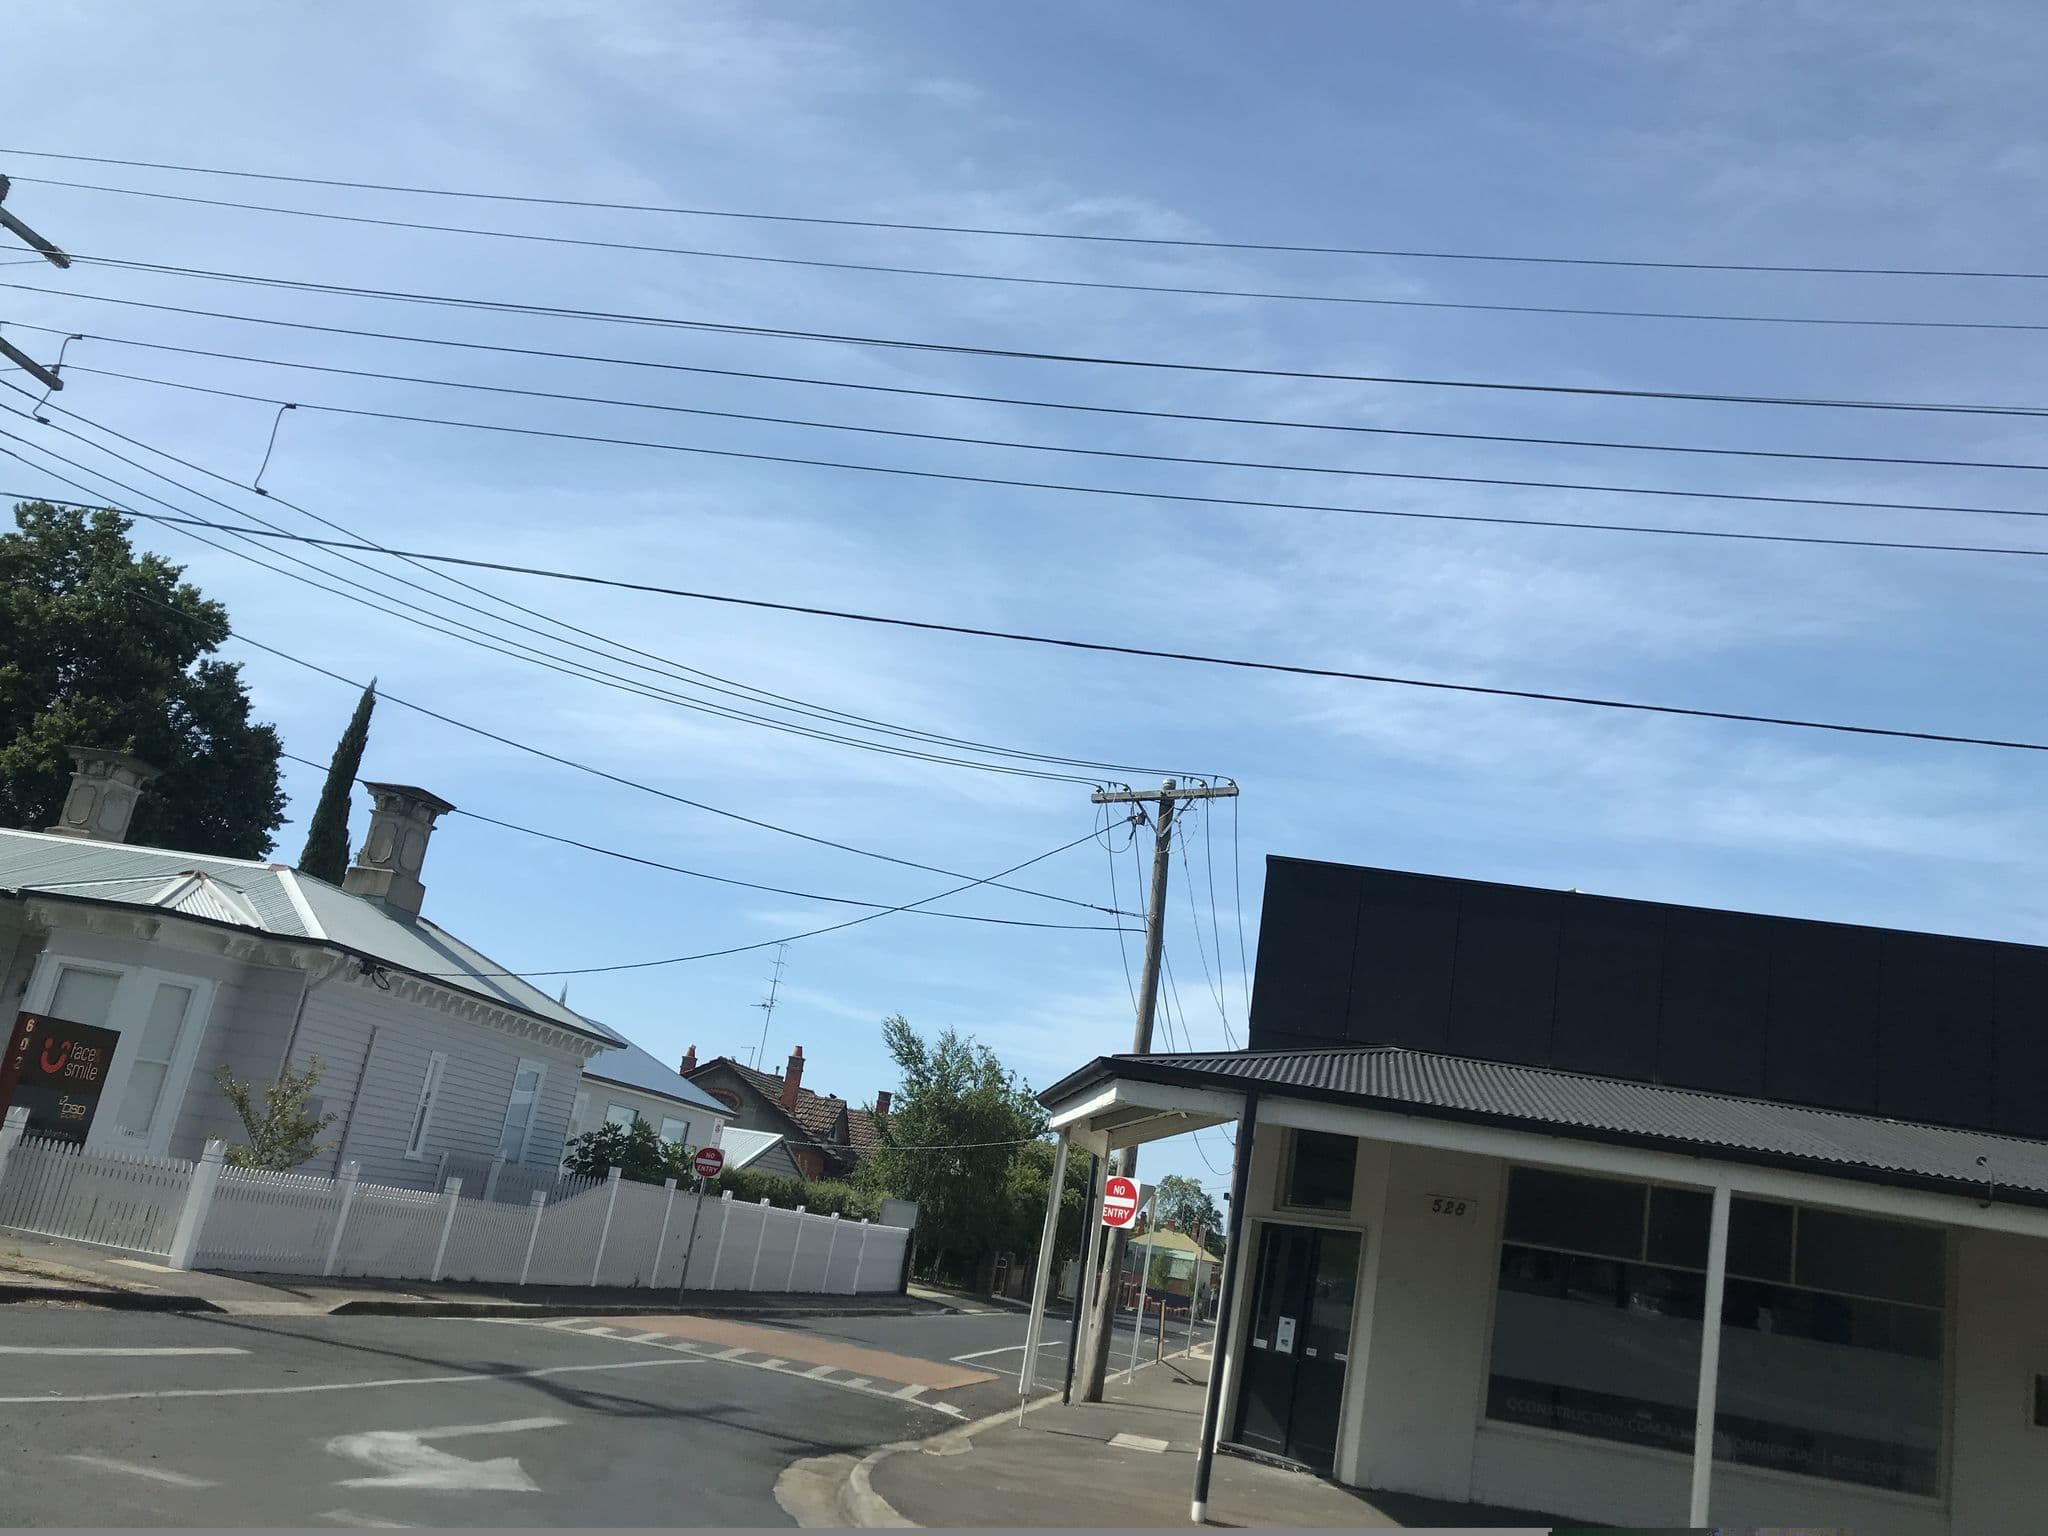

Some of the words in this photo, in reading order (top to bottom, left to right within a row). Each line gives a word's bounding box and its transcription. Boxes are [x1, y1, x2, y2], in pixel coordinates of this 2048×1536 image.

[70, 1041, 97, 1062] face
[64, 1061, 98, 1081] smile
[697, 1165, 719, 1173] ENTRY
[1113, 1184, 1126, 1196] NO
[1102, 1206, 1130, 1220] ENTRY
[1432, 1199, 1466, 1216] 528
